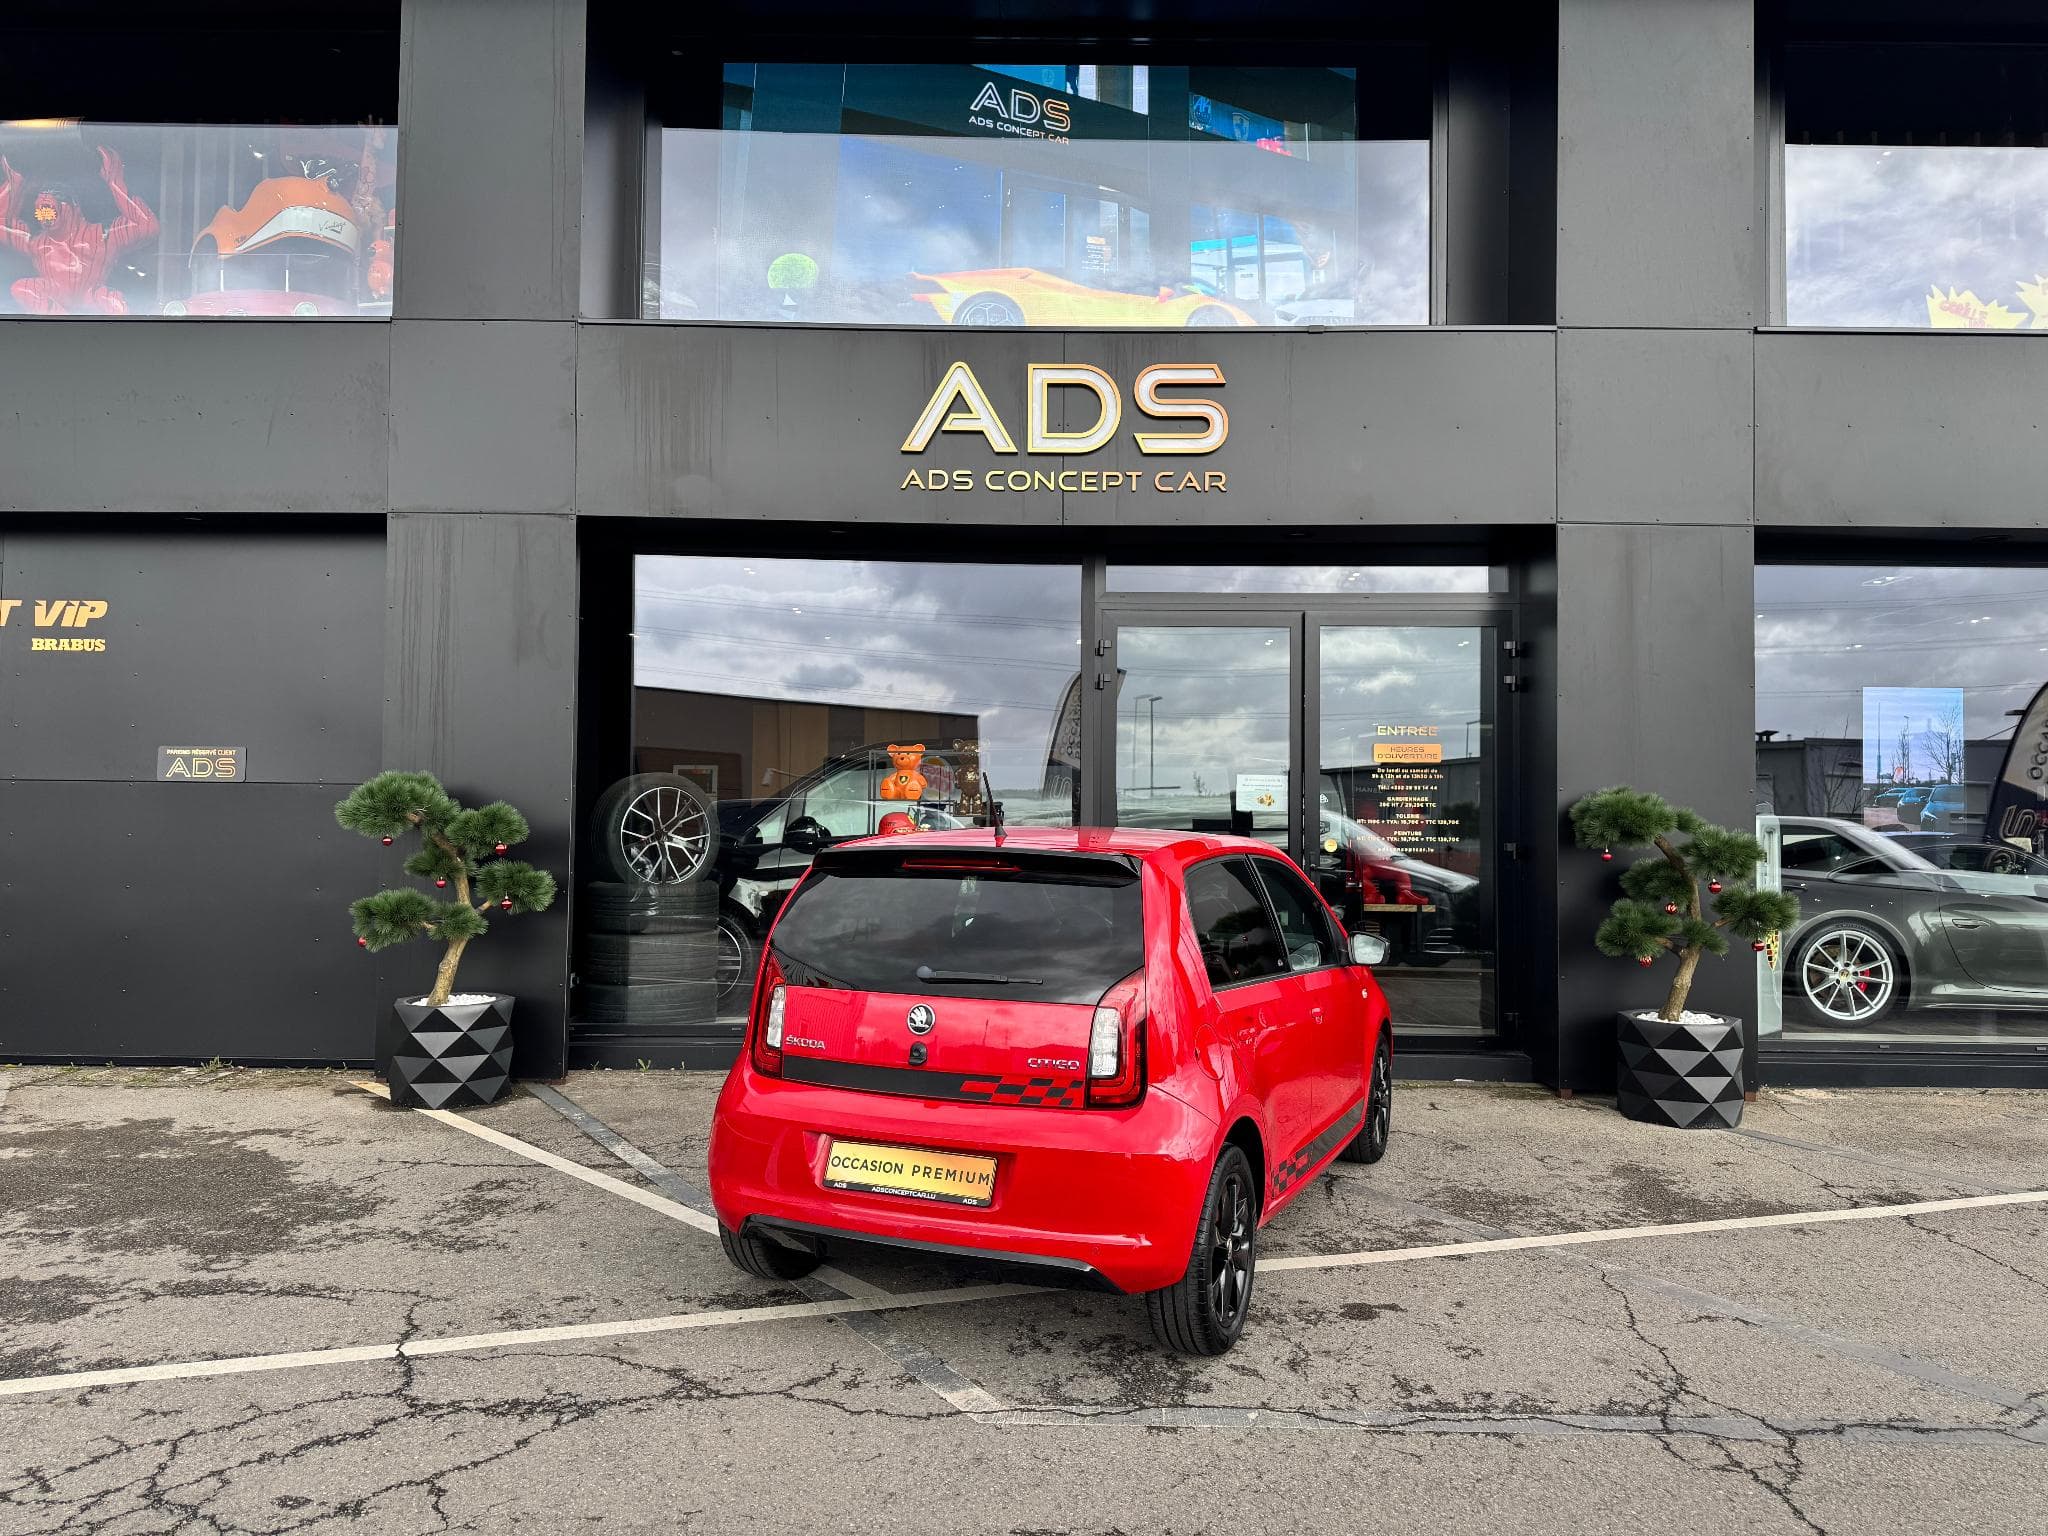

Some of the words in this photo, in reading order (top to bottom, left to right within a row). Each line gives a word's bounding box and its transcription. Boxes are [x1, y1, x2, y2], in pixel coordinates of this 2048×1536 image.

[970, 82, 1070, 132] ADS
[969, 116, 994, 129] ADS
[997, 121, 1045, 140] CONCEPT
[1048, 134, 1069, 145] CAR
[900, 361, 1229, 454] ADS
[900, 468, 973, 491] ADS
[985, 470, 1142, 492] CONCEPT
[1154, 471, 1228, 492] CAR
[31, 638, 106, 651] BRABUS
[165, 757, 236, 777] ADS
[785, 1034, 826, 1050] ŠKODA
[831, 1155, 904, 1175] OCCASION
[911, 1165, 990, 1186] PREMIUM
[833, 1181, 847, 1189] ADS
[871, 1186, 936, 1200] ADSCONCEPTCAR.LU
